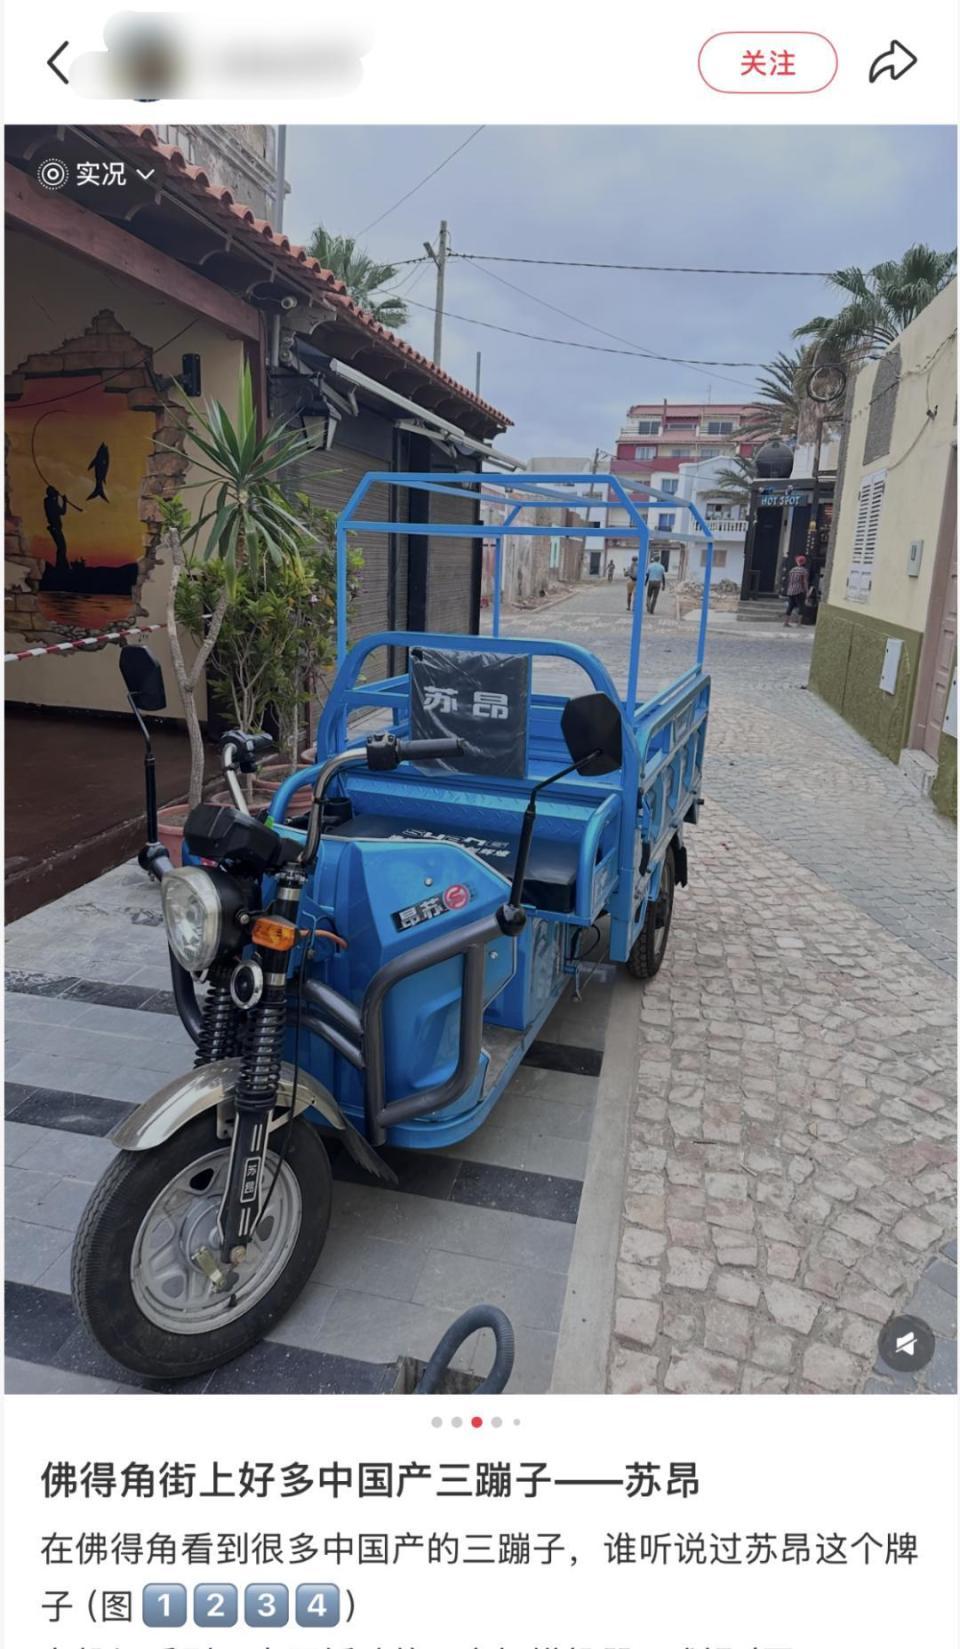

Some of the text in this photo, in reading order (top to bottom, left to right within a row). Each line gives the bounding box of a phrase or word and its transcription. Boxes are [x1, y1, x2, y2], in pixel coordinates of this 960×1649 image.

[761, 495, 801, 506] HOT SPOT
[423, 685, 509, 720] 苏昂
